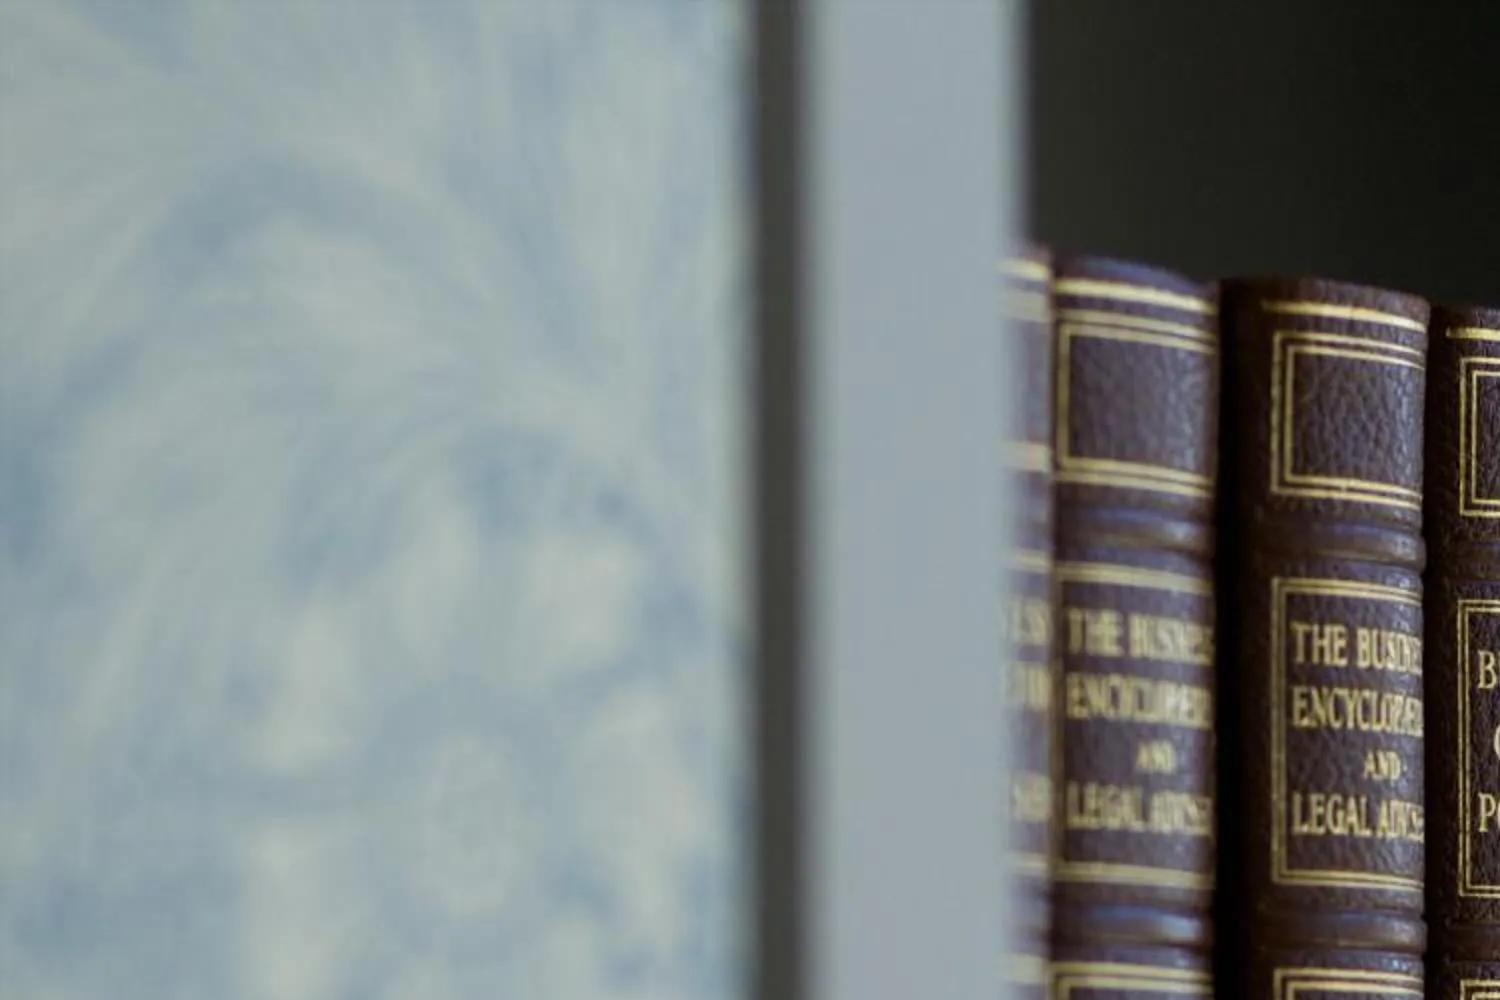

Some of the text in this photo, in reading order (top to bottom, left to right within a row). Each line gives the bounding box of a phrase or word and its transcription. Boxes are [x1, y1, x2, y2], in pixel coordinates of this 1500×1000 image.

[1290, 620, 1348, 668] THE
[1362, 751, 1402, 783] AND
[1292, 794, 1373, 838] LEGAL
